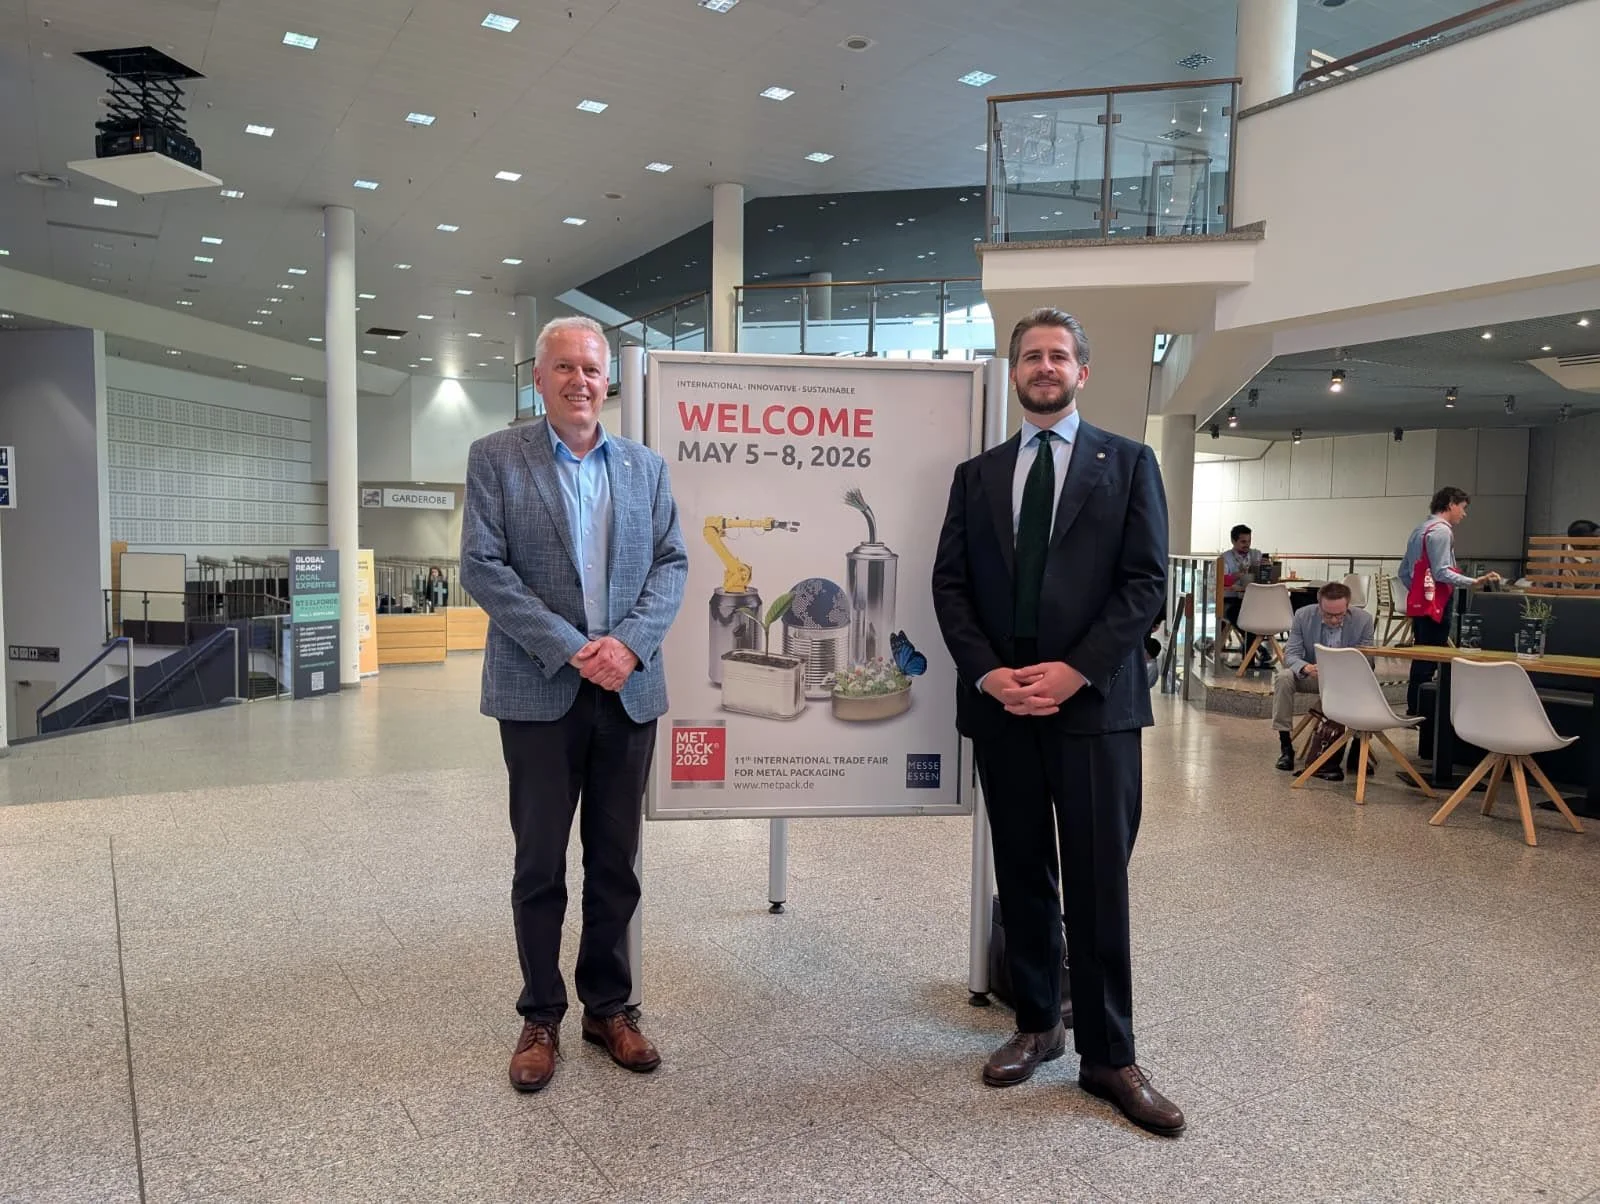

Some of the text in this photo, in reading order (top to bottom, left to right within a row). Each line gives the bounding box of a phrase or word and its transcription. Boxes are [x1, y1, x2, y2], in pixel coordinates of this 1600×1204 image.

[677, 380, 856, 395] INTERNATIONAL INNOVATIVE SUSTAINABLE
[678, 401, 874, 438] WELCOME
[678, 441, 738, 464] MAY
[810, 445, 871, 468] 2026
[391, 494, 447, 505] GARDEROBE
[295, 556, 325, 564] GLOBAL
[295, 564, 321, 572] REACH
[676, 731, 708, 743] MET
[675, 754, 709, 766] 2026
[753, 756, 831, 765] INTERNATIONAL
[833, 756, 865, 765] TRADE
[868, 756, 889, 765] FAIR
[908, 760, 939, 770] MESSE
[734, 768, 846, 777] FOR METAL PACKAGING
[907, 771, 939, 781] ESSEN
[733, 780, 815, 791] www.metpack.de
